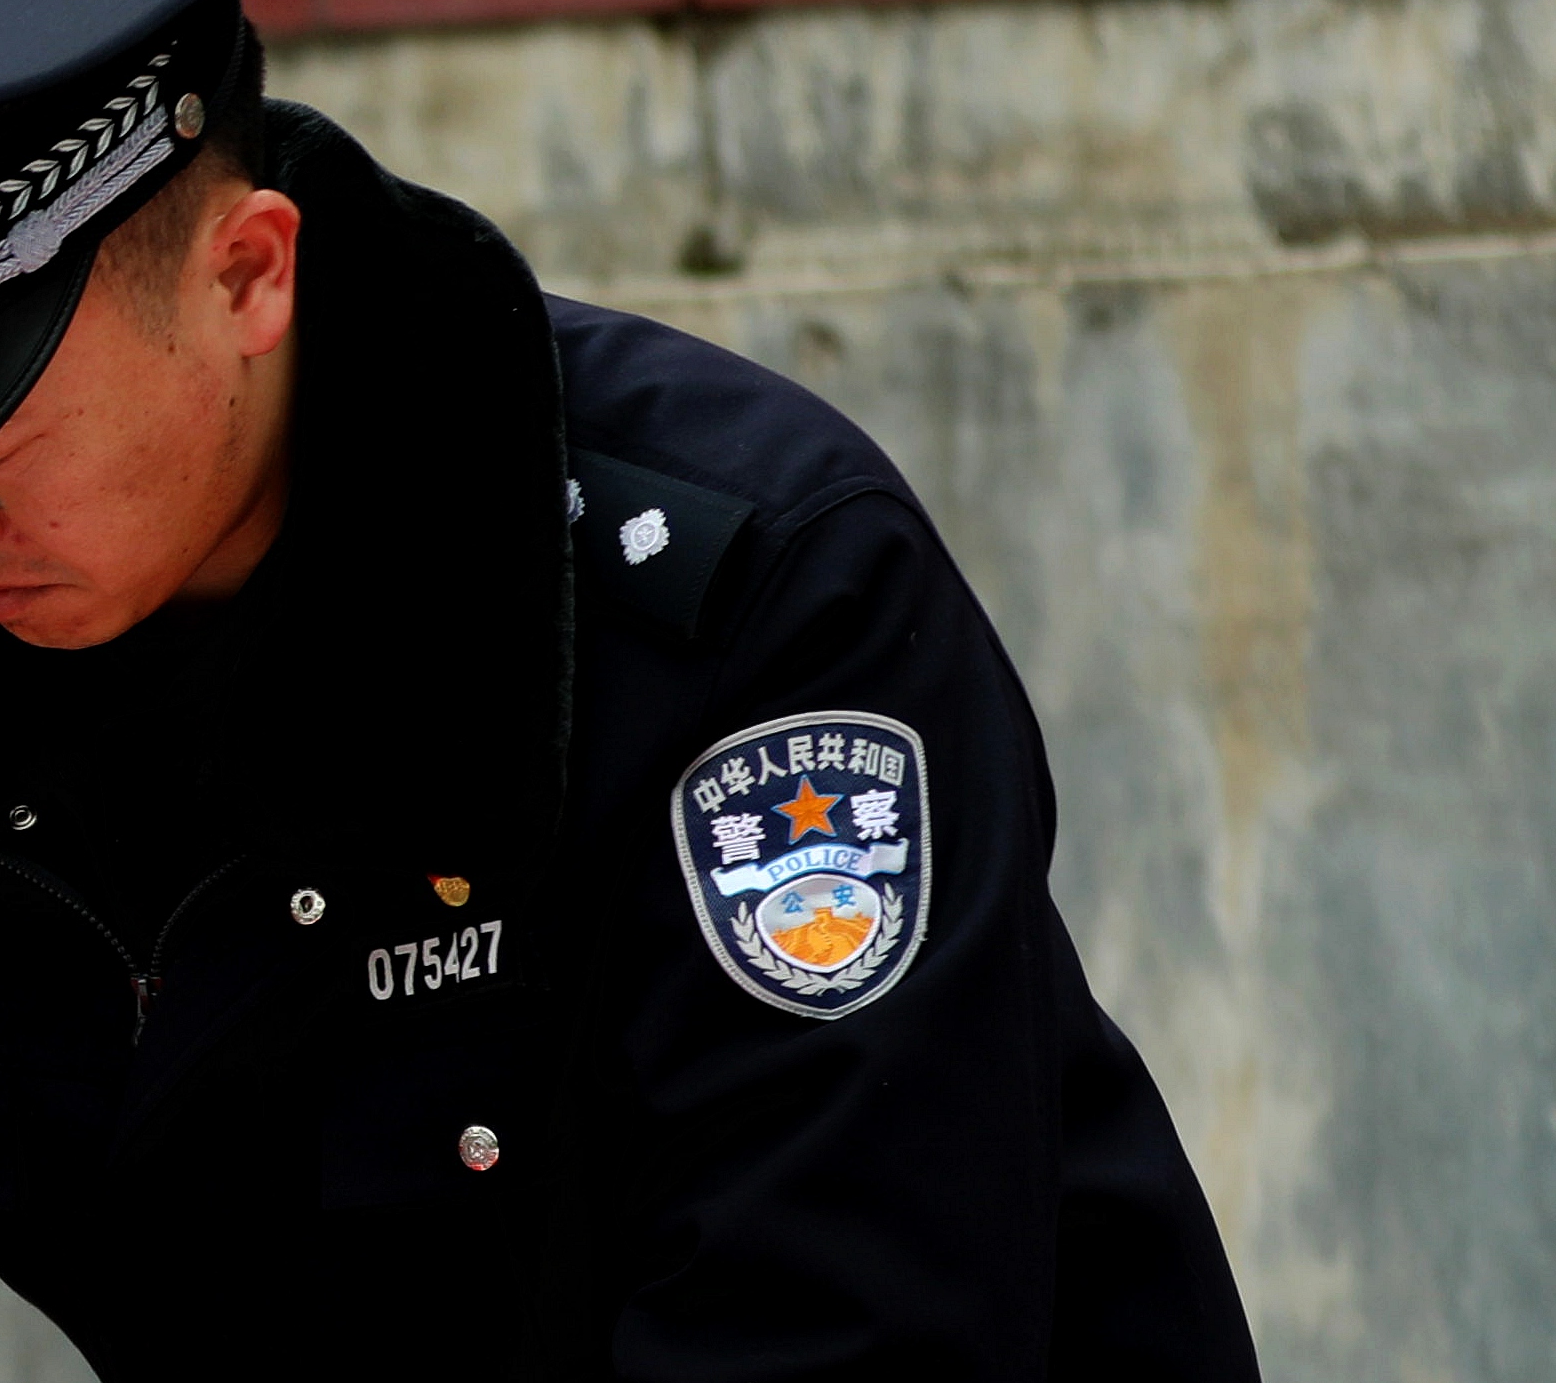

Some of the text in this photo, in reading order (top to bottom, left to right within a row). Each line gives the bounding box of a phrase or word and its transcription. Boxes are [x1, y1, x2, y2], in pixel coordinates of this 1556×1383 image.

[693, 732, 907, 814] 中华人民共和国
[767, 848, 863, 884] POLICE
[367, 919, 503, 1001] 075427
